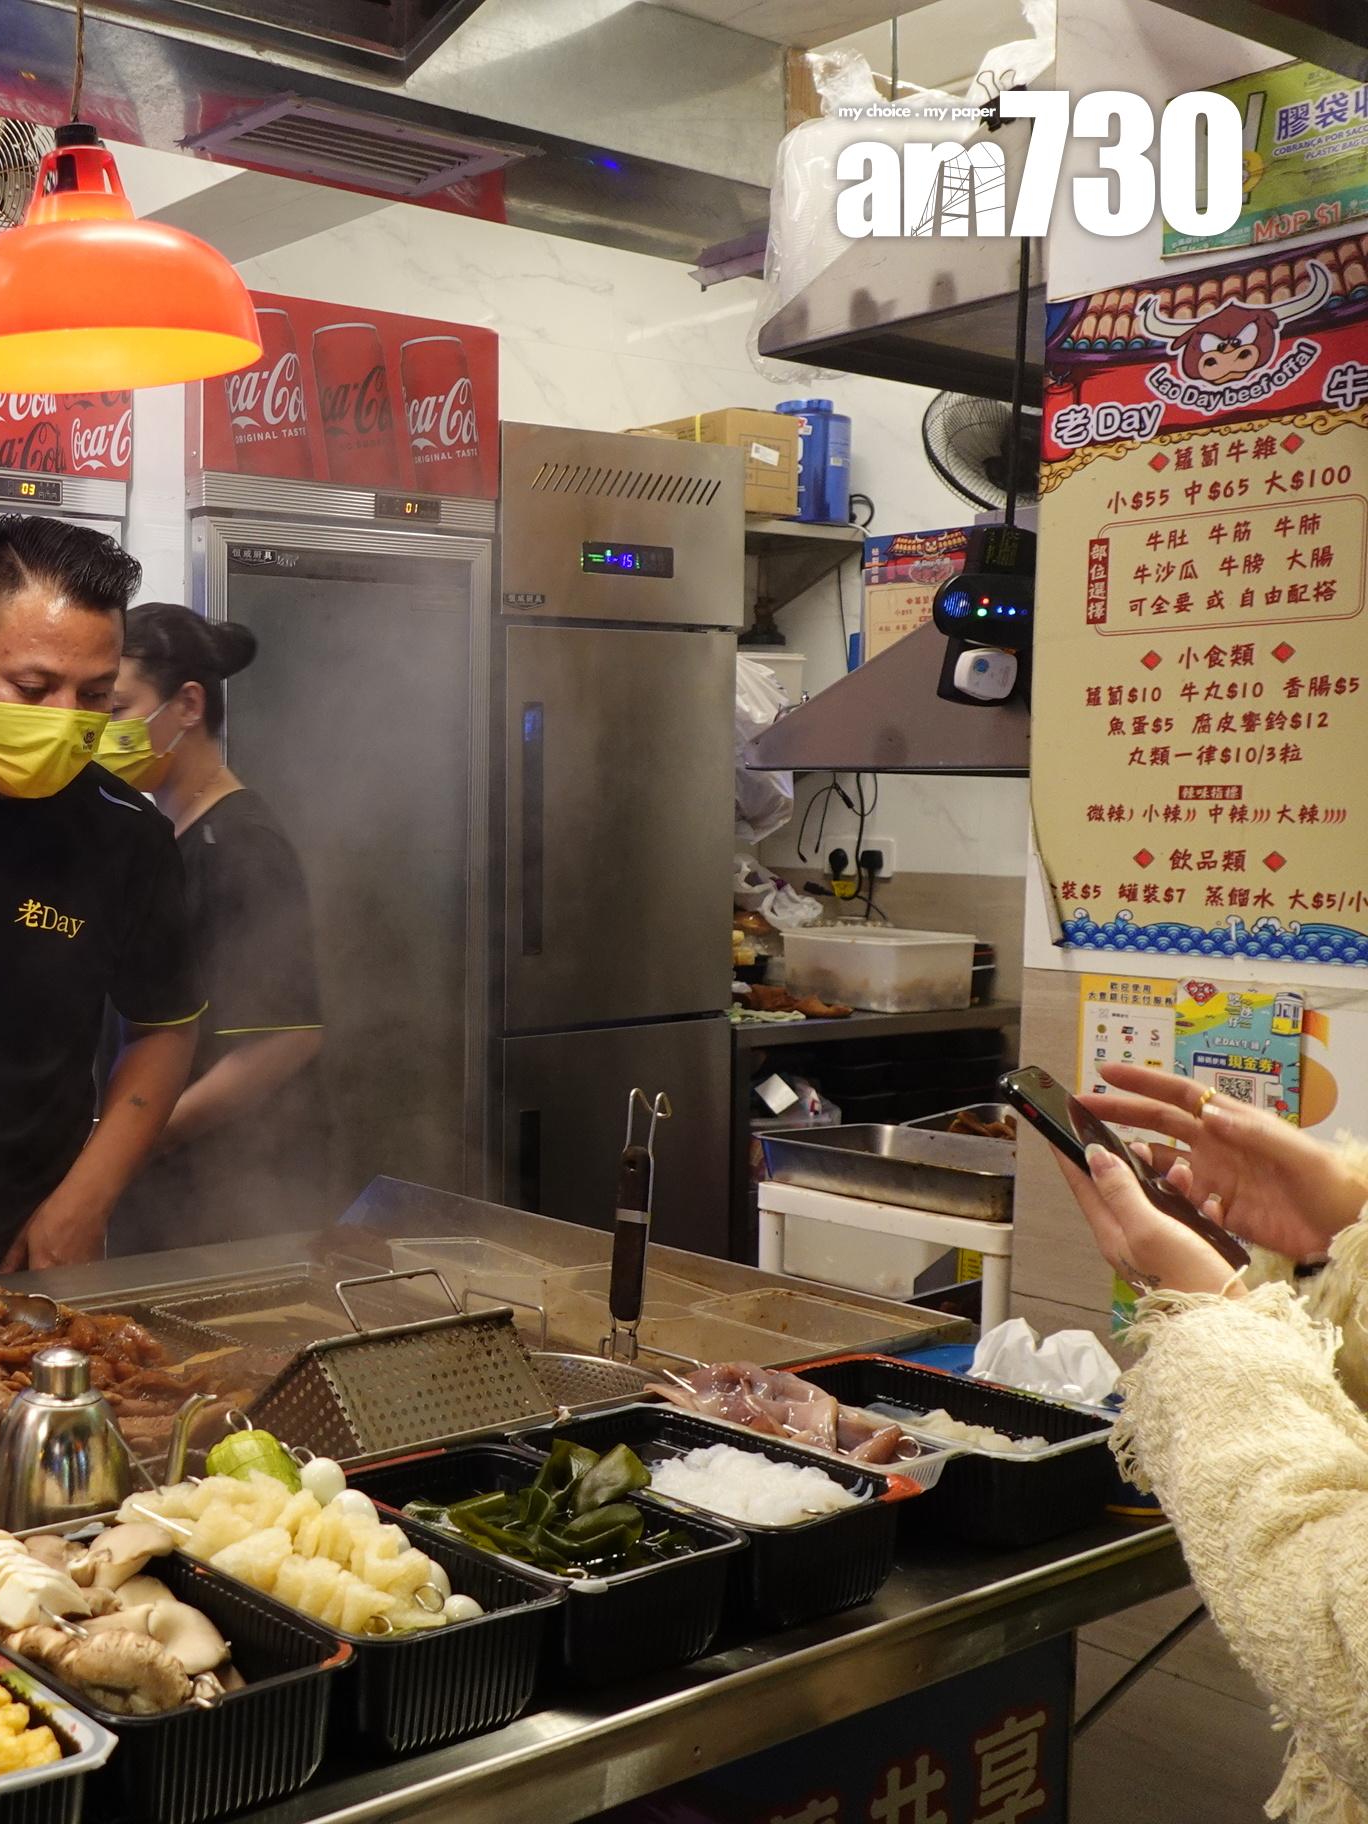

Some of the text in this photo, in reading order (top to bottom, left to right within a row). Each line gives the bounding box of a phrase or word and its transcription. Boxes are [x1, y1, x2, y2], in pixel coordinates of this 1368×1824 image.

[1254, 211, 1310, 243] MOP
[1315, 201, 1341, 226] $1
[1148, 340, 1319, 412] Lao Day beef offal
[1174, 436, 1278, 471] 蘿蔔牛雜
[21, 482, 36, 496] 03
[1107, 465, 1351, 514] 小$55 中$65 大$100
[1146, 513, 1321, 552] 牛肚 牛筋 牛肺
[1133, 559, 1198, 584] 牛沙瓜
[1286, 545, 1334, 570] 大腸
[1088, 543, 1108, 619] 部位選擇
[1178, 643, 1255, 669] 小食類
[1085, 675, 1360, 707] 蘿蔔$10 牛丸$10 香腸$5
[1107, 710, 1329, 737] 魚蛋$5 腐皮響鈴$12
[1128, 743, 1303, 766] 丸類一律$10/3粒
[1142, 804, 1182, 823] 小辣
[1208, 804, 1249, 824] 中辣
[1277, 804, 1320, 824] 大辣
[1169, 849, 1247, 873] 飲品類
[1118, 882, 1186, 904] 罐裝$7
[1204, 885, 1275, 909] 蒸餾水
